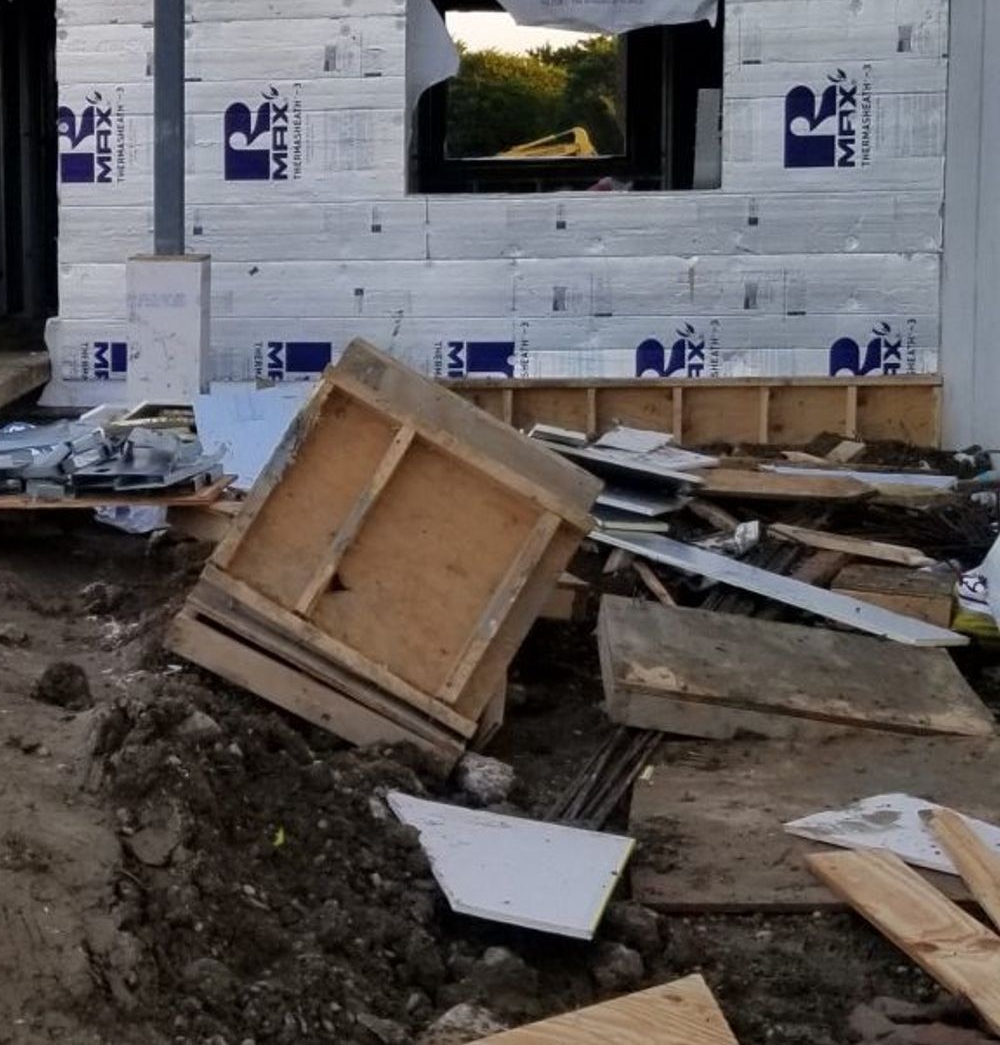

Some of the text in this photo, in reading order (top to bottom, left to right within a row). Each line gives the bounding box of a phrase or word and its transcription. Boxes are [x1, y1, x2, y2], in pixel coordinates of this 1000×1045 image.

[96, 107, 112, 183] MAX
[271, 103, 289, 180] MAX
[837, 85, 857, 167] MAX
